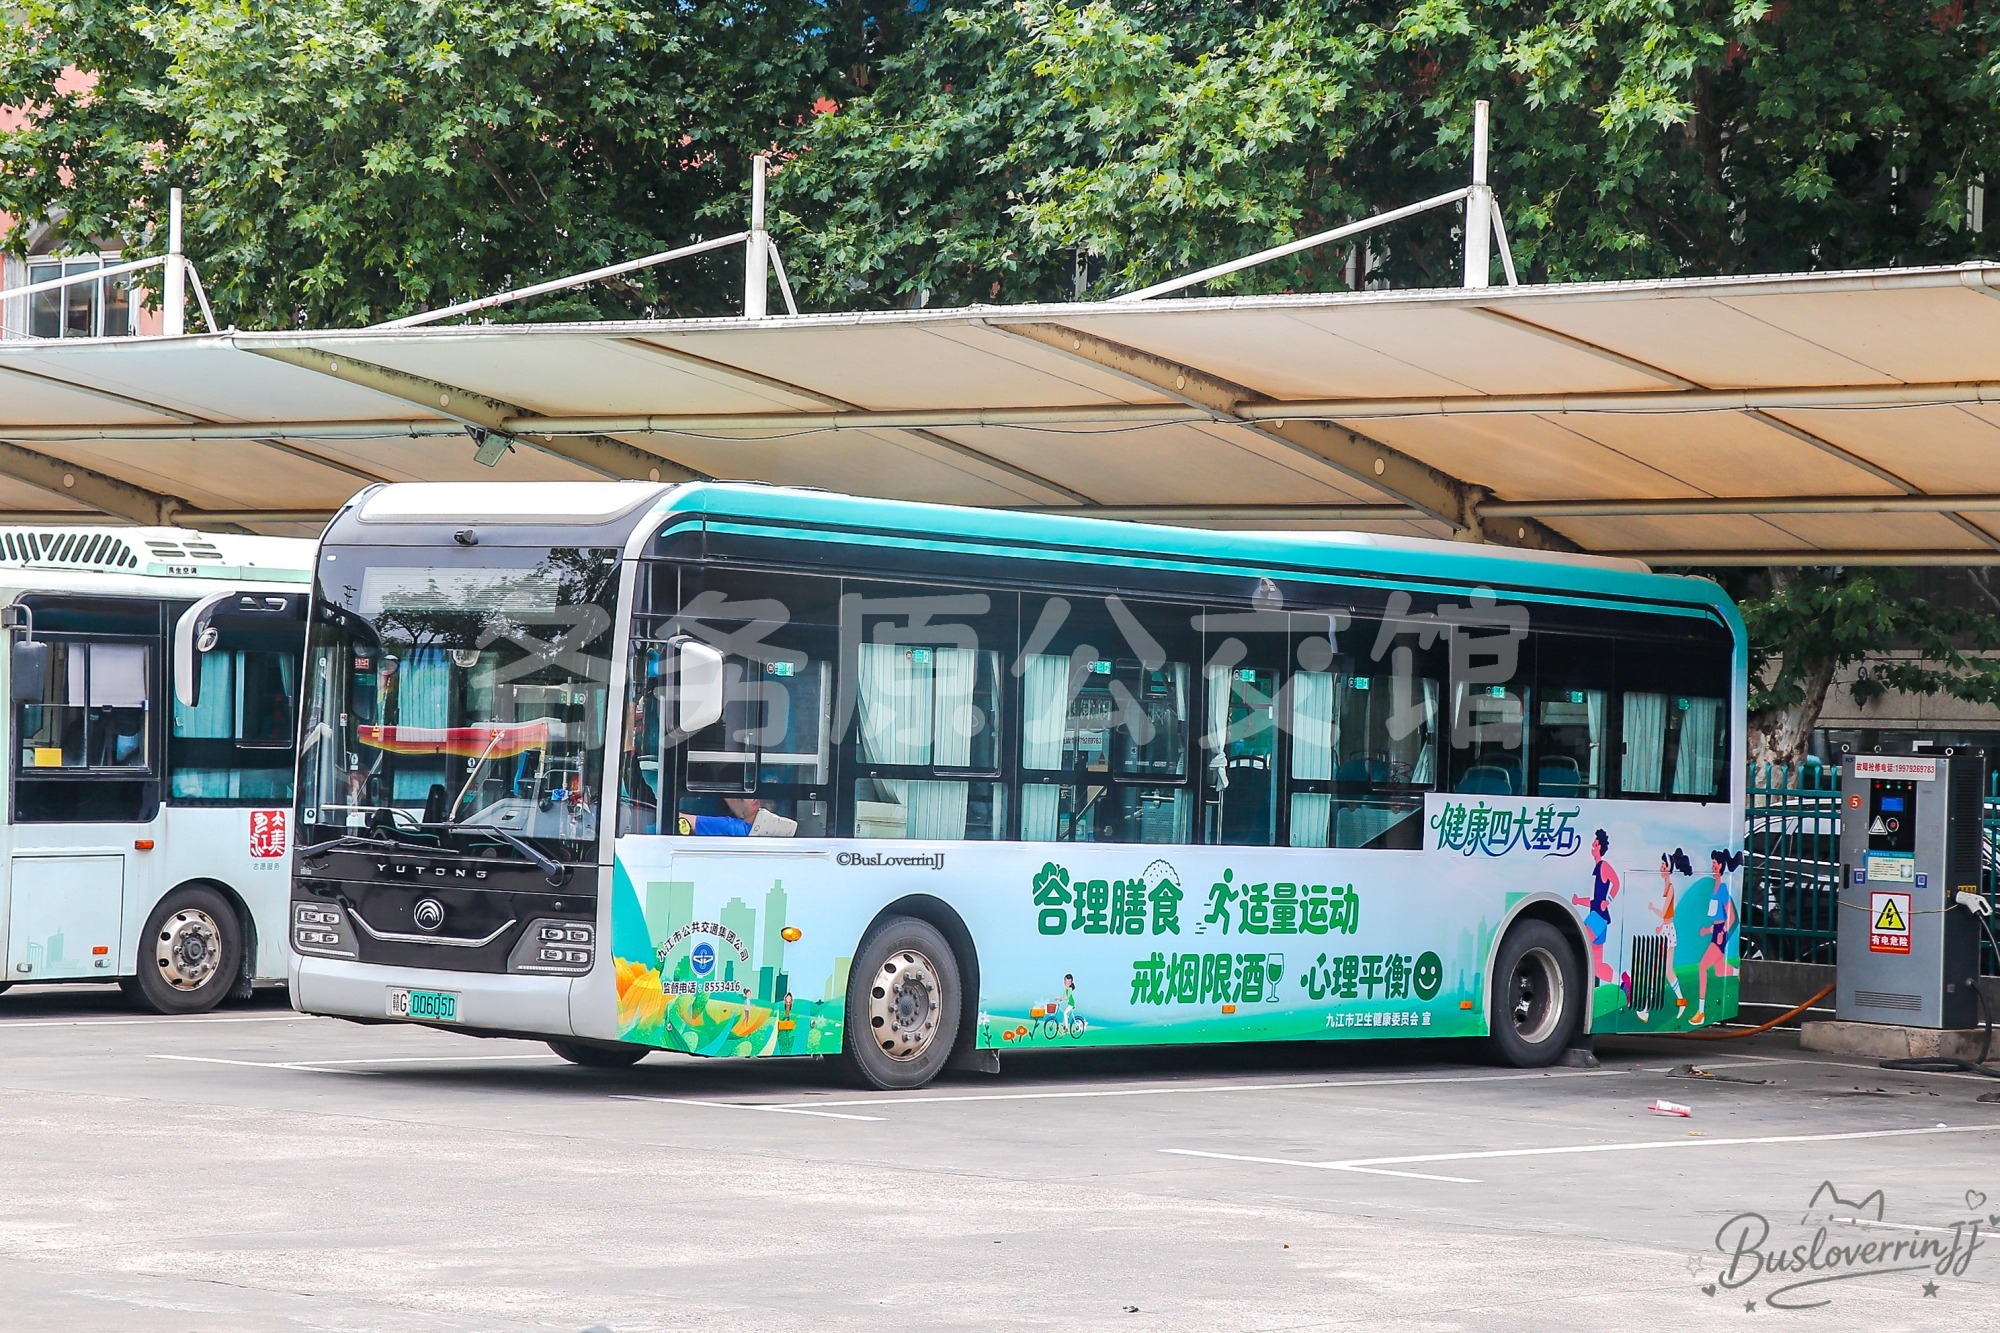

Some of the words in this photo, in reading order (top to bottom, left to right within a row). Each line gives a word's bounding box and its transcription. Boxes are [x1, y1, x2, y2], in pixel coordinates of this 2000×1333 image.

[1852, 798, 1858, 808] 5
[1431, 801, 1581, 859] 健康四大基石
[377, 863, 487, 878] YUTONG
[1032, 864, 1184, 936] 合理膳食
[1238, 883, 1359, 935] 适量运动
[657, 920, 749, 962] 九江市公共交通集团公司
[1871, 935, 1909, 946] 有电危险
[1130, 951, 1265, 1005] 戒烟限酒
[1301, 953, 1412, 1001] 心理平衡
[1325, 1012, 1419, 1027] 九江市卫生健康委员会
[1421, 1011, 1431, 1026] 宣
